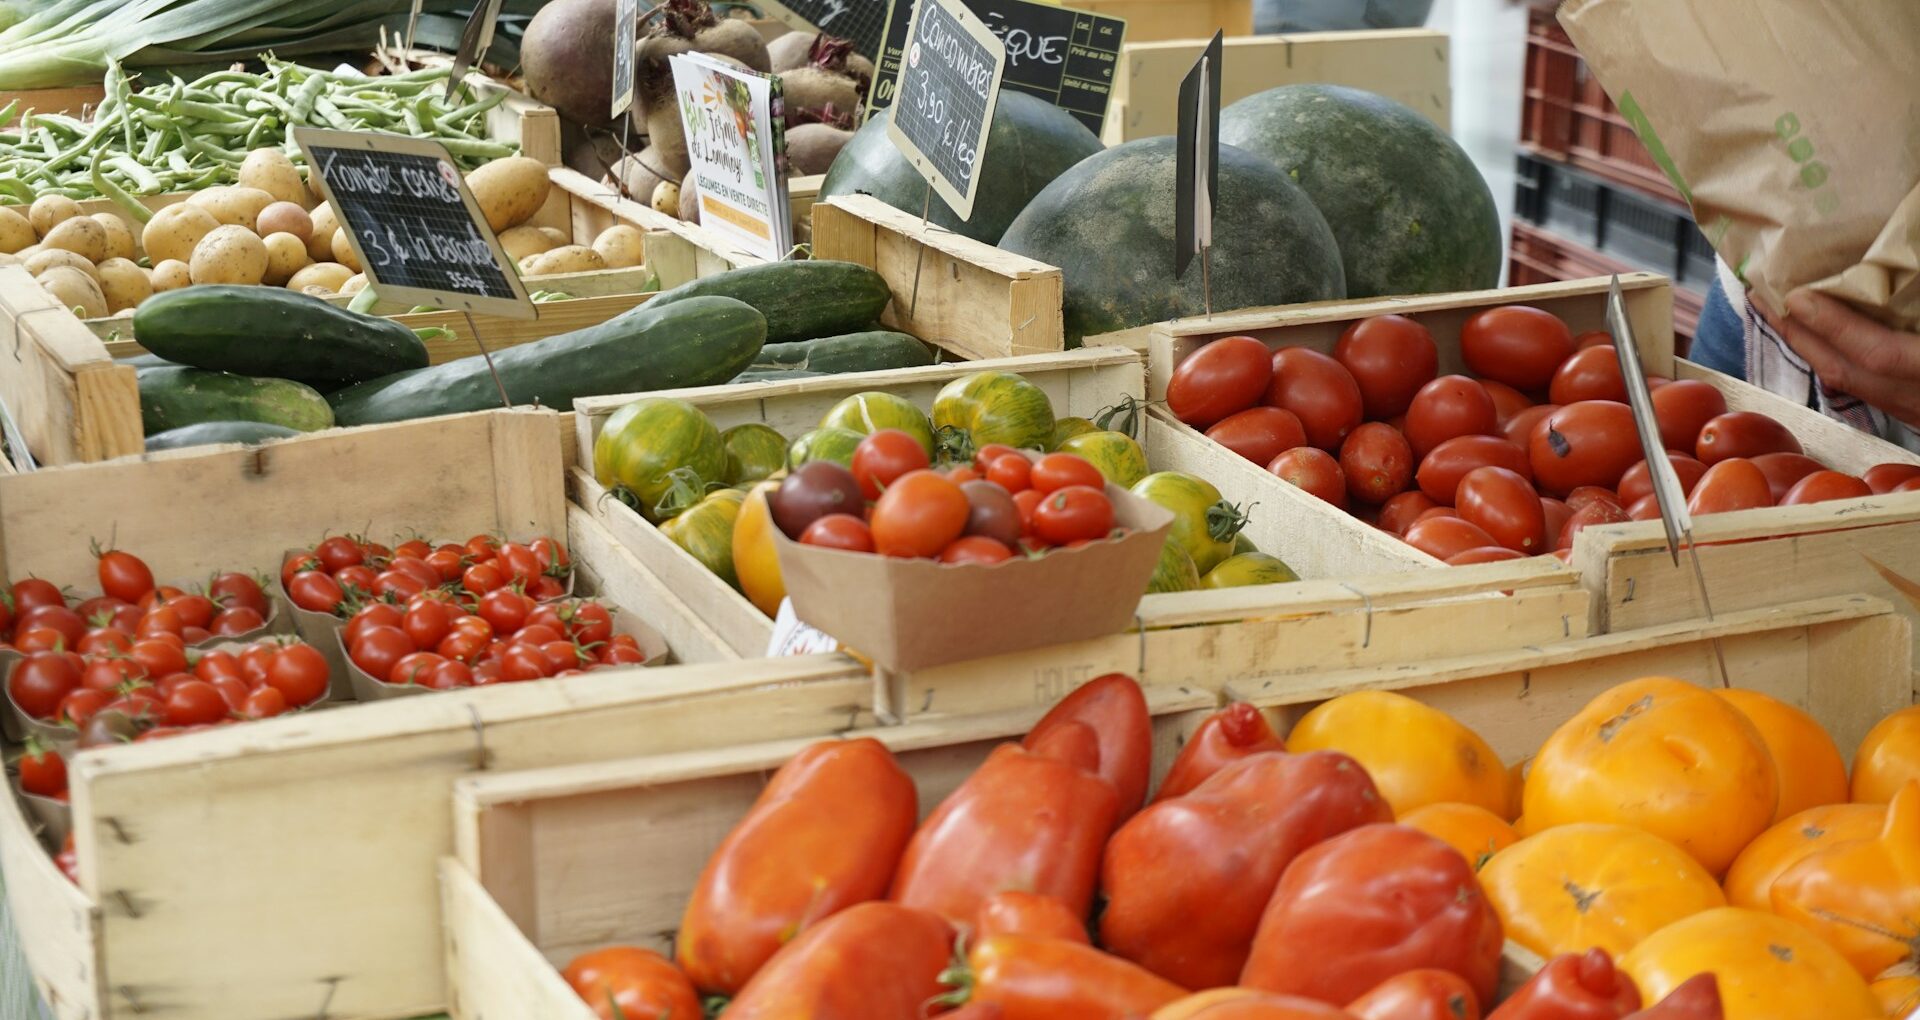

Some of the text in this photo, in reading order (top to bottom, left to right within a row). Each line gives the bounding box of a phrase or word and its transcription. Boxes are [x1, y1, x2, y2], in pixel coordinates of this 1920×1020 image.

[921, 4, 993, 100] Concombres
[877, 78, 897, 101] Or
[917, 70, 944, 124] 3,90
[322, 151, 402, 196] Tomates
[363, 229, 391, 266] 3
